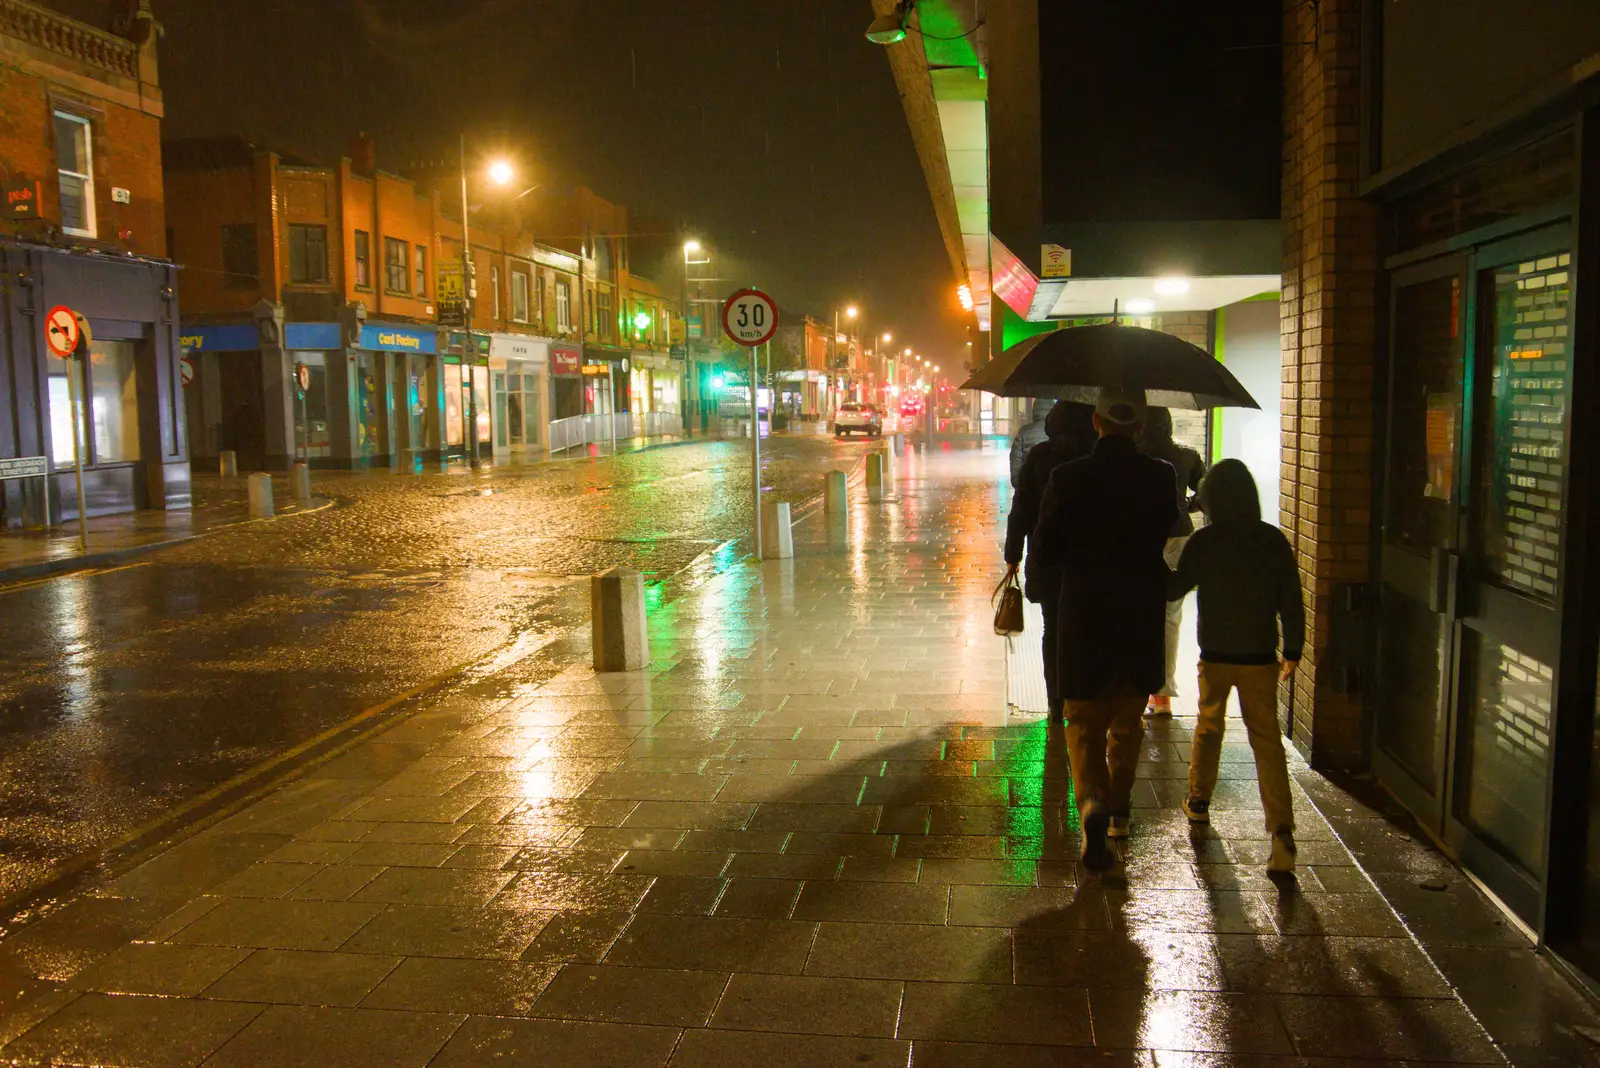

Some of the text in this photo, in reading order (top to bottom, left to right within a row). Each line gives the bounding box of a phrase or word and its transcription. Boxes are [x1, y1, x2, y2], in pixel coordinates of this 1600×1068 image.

[737, 304, 764, 327] 30
[378, 332, 420, 349] Card Factory
